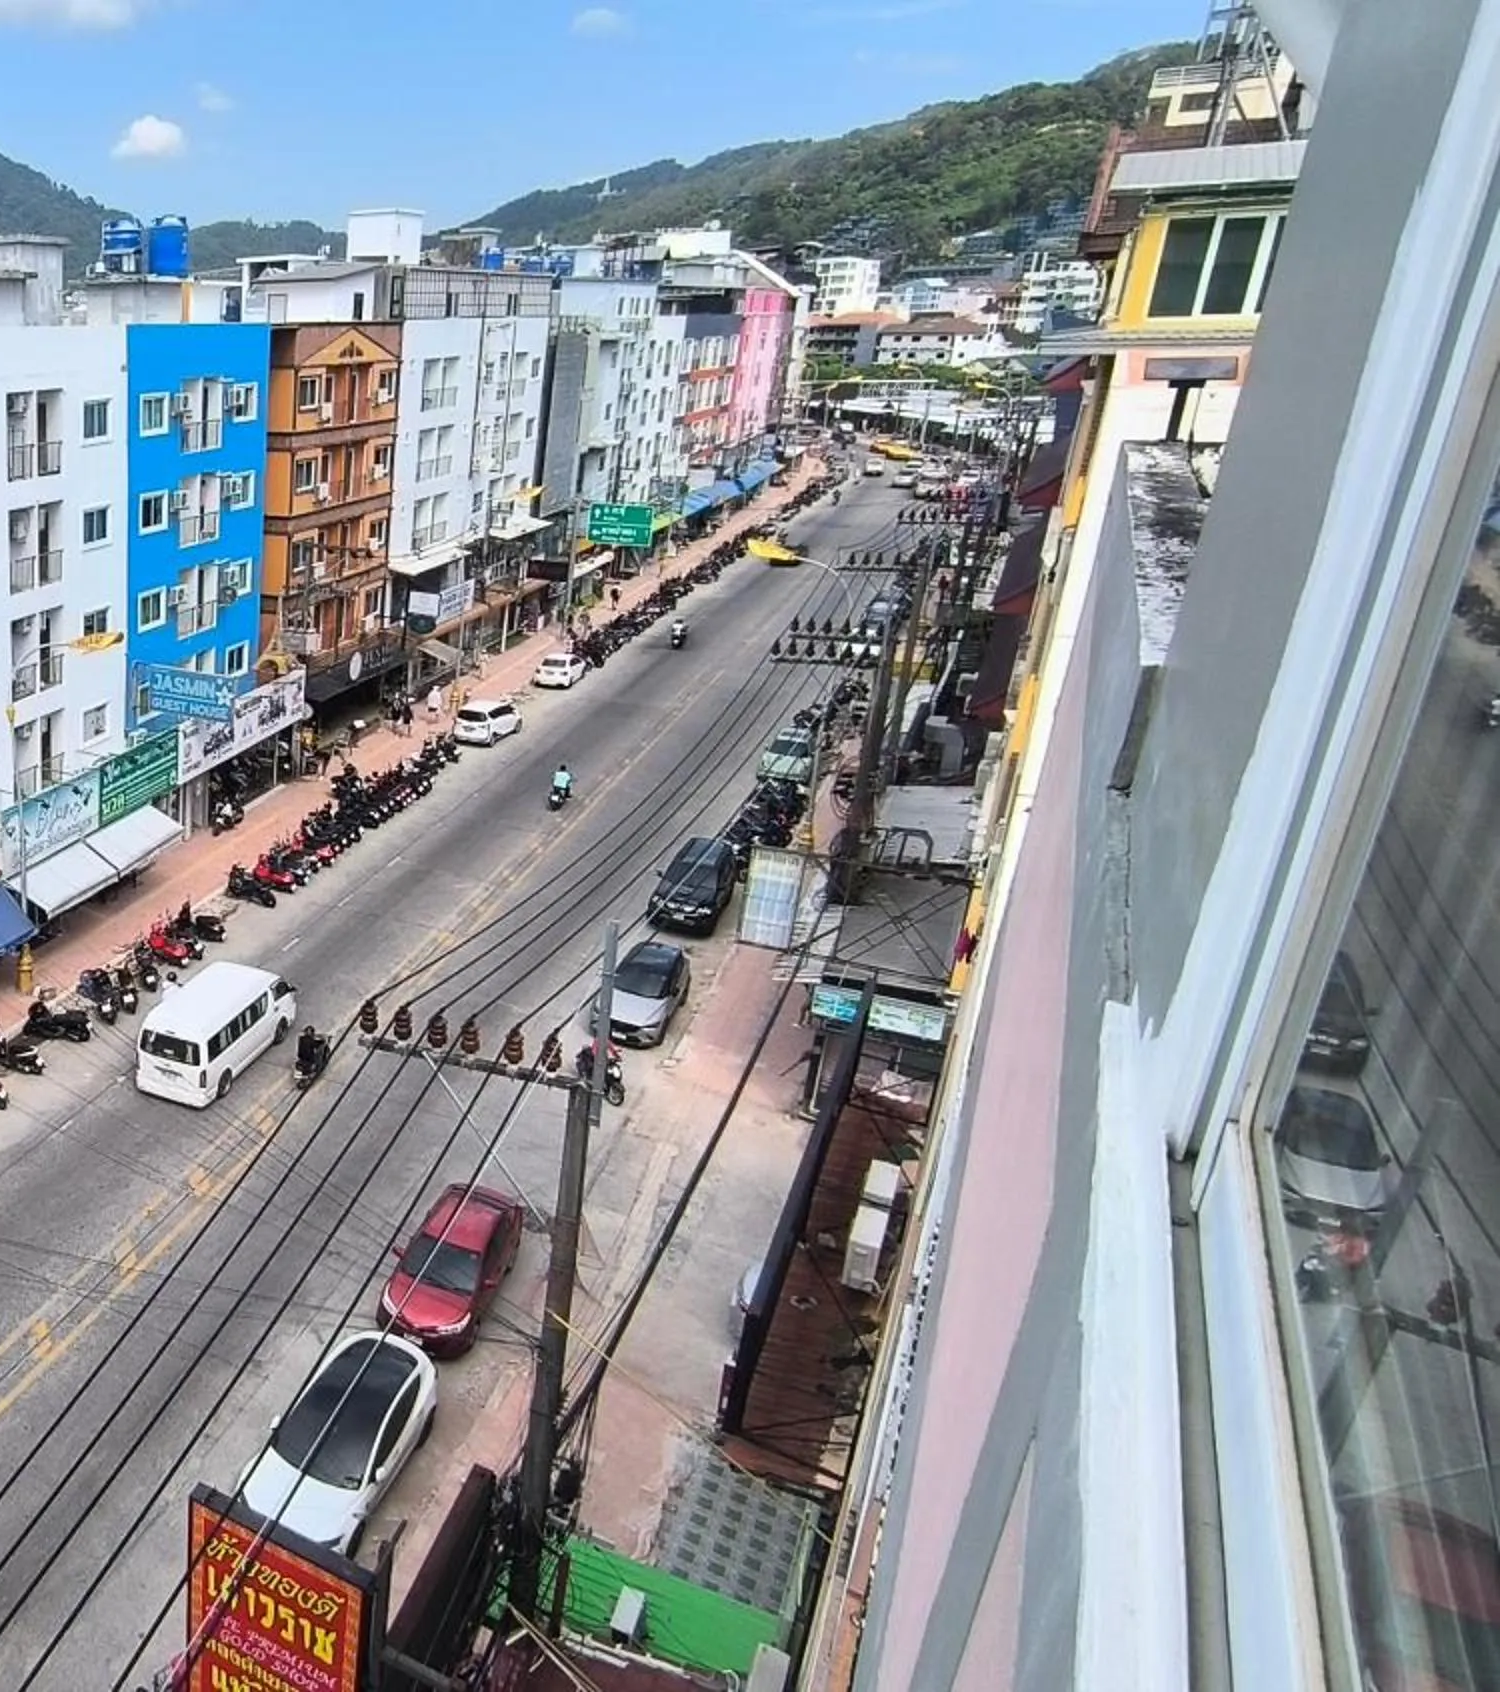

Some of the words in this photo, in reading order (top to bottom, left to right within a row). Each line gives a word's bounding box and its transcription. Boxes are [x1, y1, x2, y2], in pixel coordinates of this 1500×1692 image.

[152, 673, 216, 700] JASMIN
[152, 696, 188, 713] GUEST
[189, 703, 229, 721] HOUSE
[219, 1628, 266, 1662] GOLD
[270, 1659, 320, 1692] SHOP
[247, 1630, 338, 1689] PREMIUM
